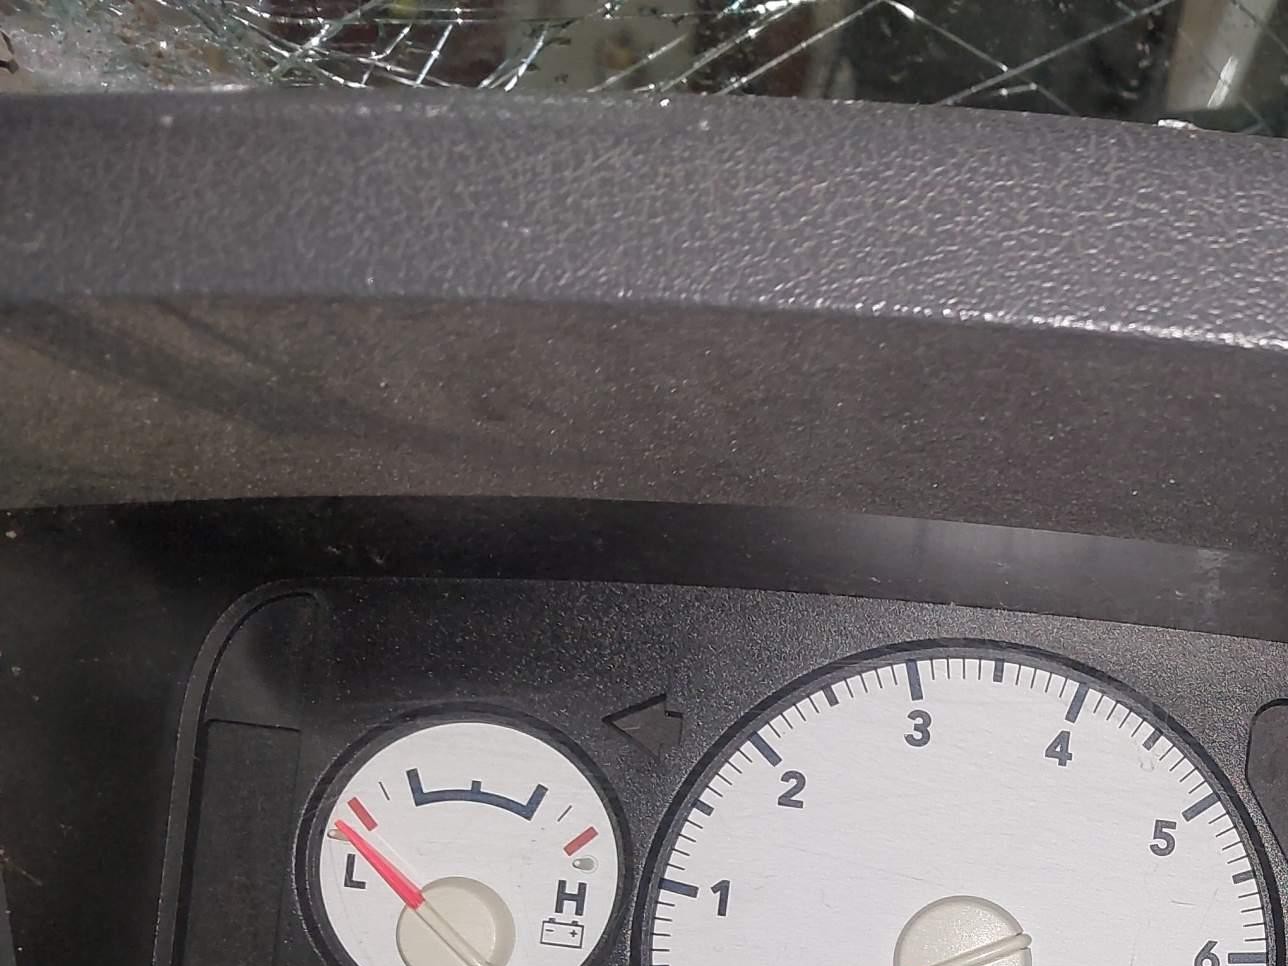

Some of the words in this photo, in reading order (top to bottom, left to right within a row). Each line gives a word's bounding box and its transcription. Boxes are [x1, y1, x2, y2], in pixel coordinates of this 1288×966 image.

[904, 709, 932, 747] 3
[1044, 730, 1073, 766] 4
[778, 770, 807, 809] 2
[1149, 819, 1177, 856] 5
[344, 854, 366, 889] L
[554, 880, 587, 916] H
[710, 879, 731, 916] 1
